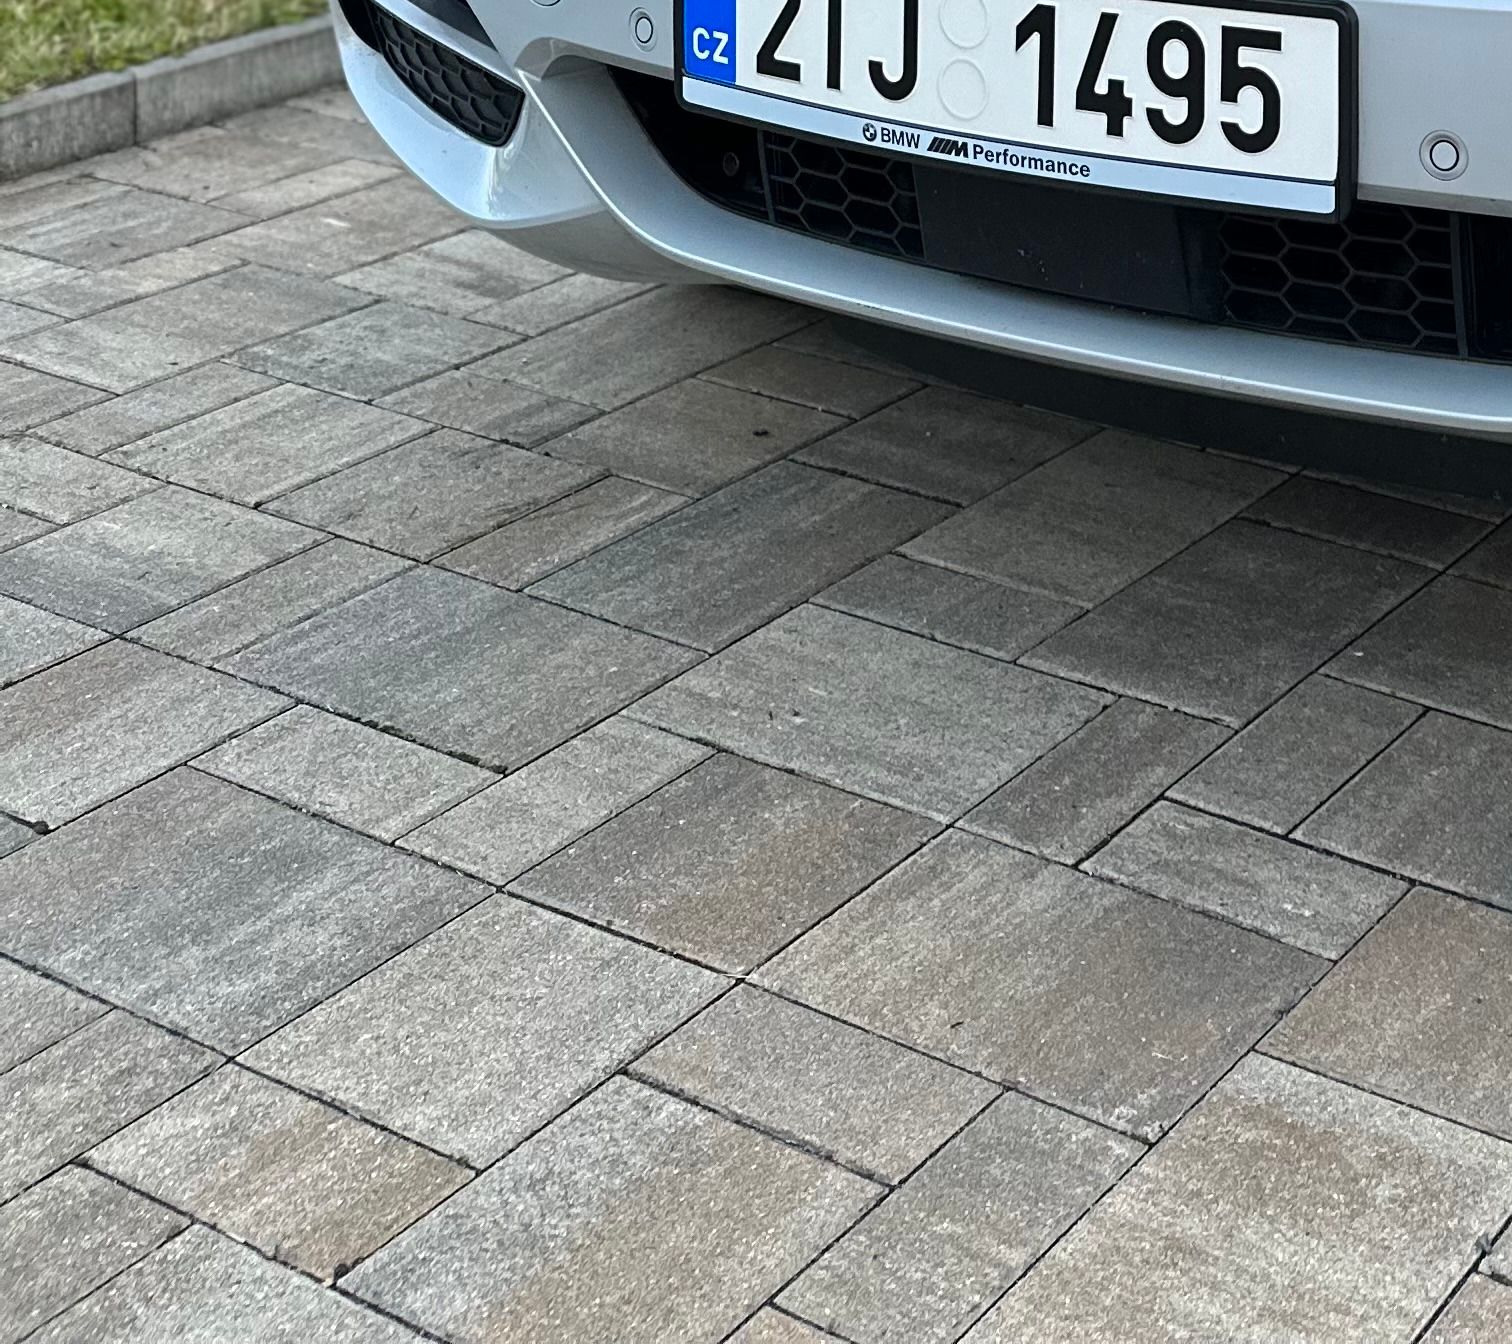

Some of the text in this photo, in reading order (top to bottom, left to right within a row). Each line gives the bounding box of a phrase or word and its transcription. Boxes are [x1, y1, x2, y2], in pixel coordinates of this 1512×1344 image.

[692, 26, 729, 65] CZ
[1014, 3, 1283, 155] 1495
[881, 127, 920, 149] BMW
[973, 143, 1091, 178] Performance
